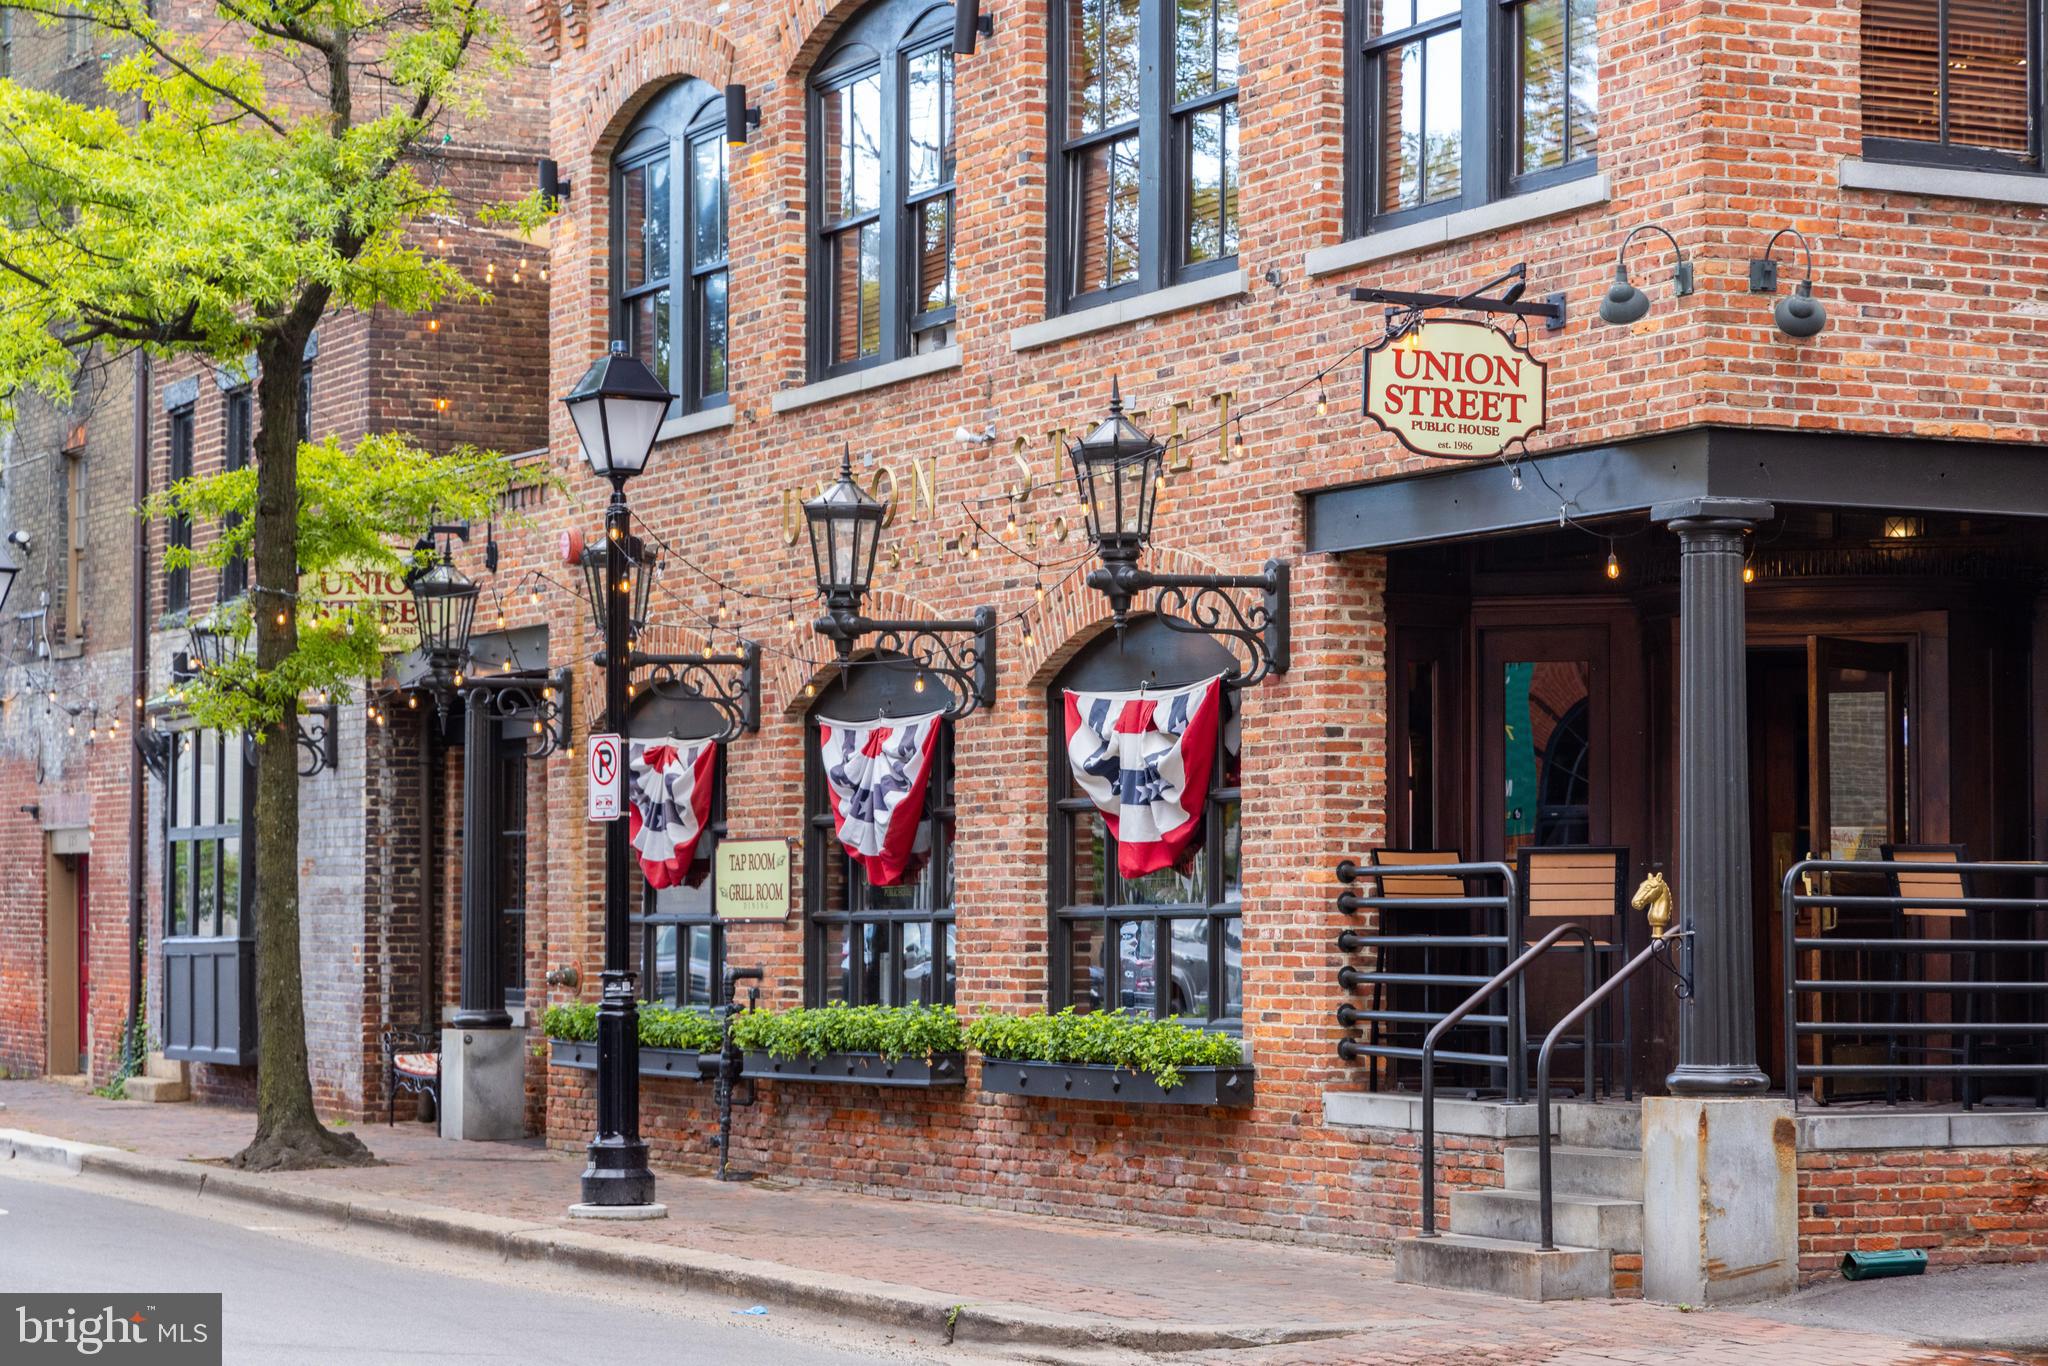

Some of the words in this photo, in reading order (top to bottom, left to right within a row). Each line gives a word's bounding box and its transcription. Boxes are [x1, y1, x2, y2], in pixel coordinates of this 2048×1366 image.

[1391, 348, 1523, 387] UNION
[1384, 384, 1528, 424] STREET
[1411, 420, 1456, 433] PUBLIC
[1458, 423, 1500, 436] HOUSE
[1437, 441, 1451, 449] est.
[1454, 441, 1473, 451] 1986
[783, 456, 937, 547] UON
[320, 571, 414, 595] UNIO
[729, 854, 747, 871] TAP
[749, 853, 776, 871] ROOM
[729, 884, 755, 901] GRILL
[756, 883, 783, 901] ROOM
